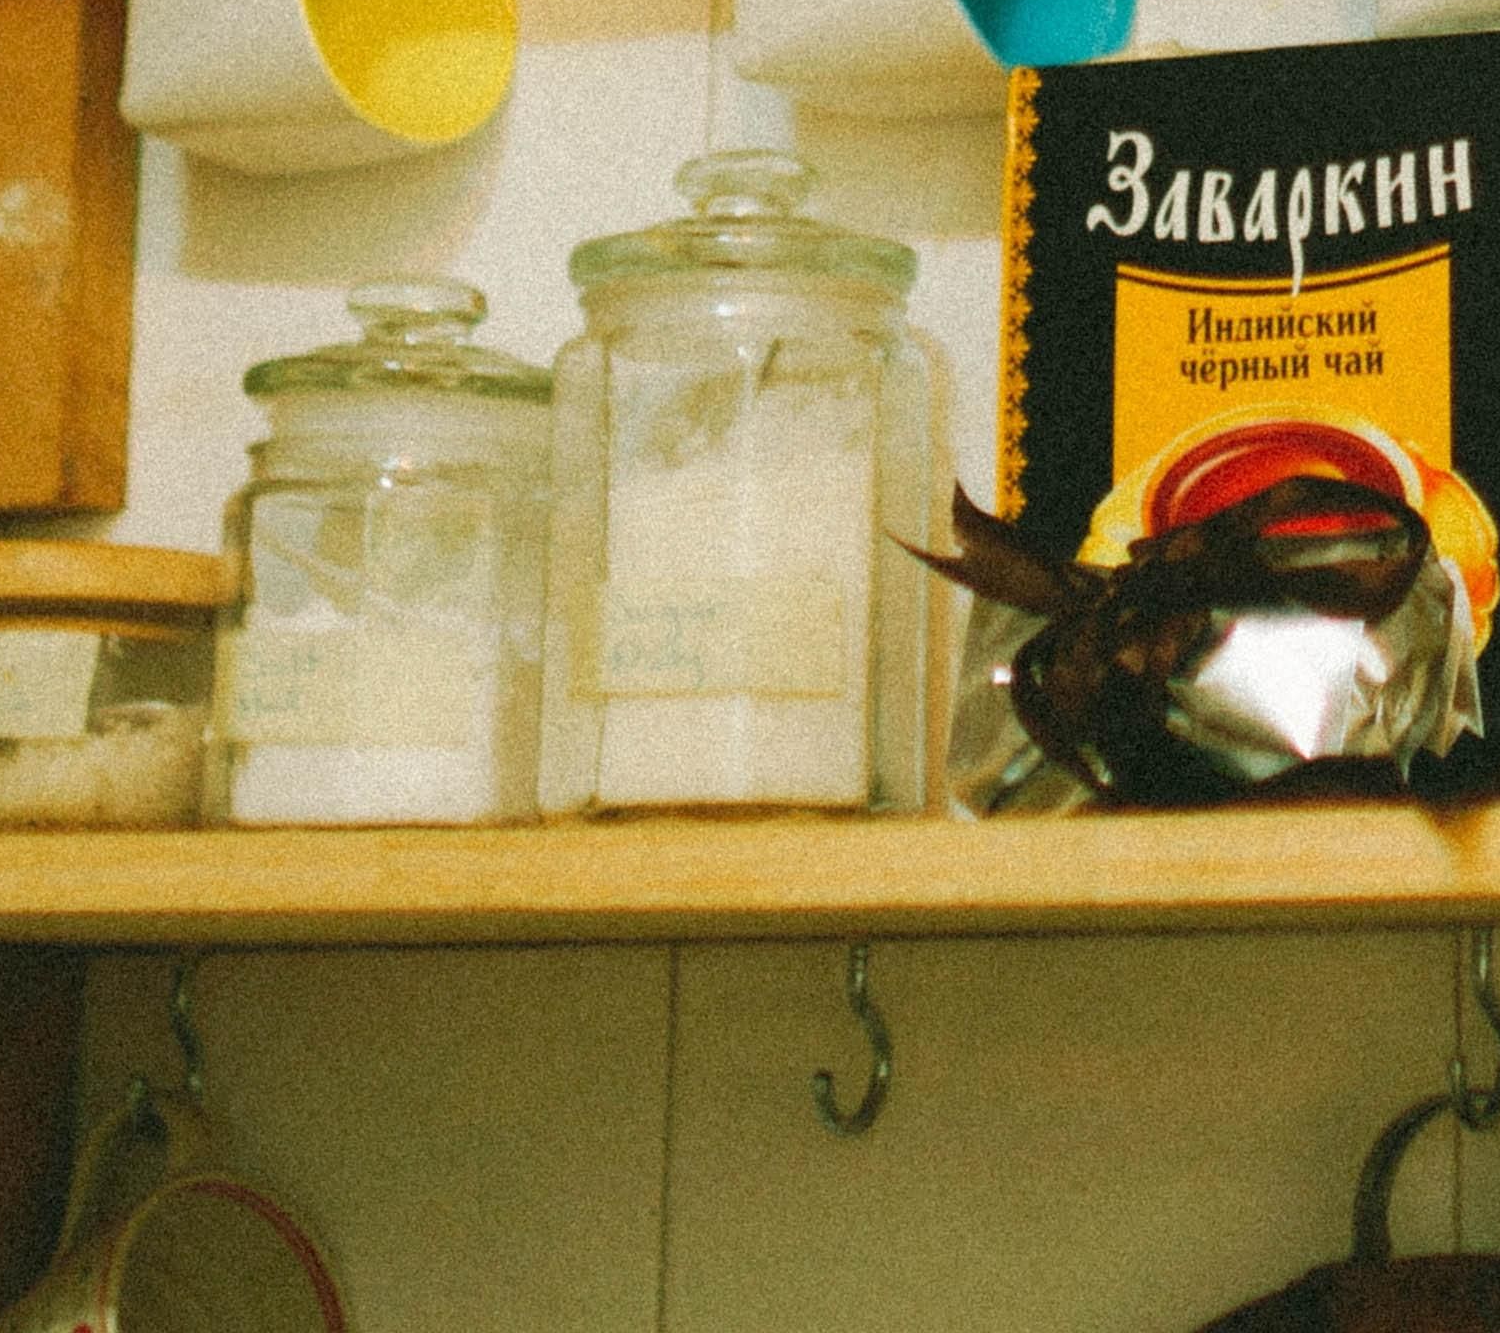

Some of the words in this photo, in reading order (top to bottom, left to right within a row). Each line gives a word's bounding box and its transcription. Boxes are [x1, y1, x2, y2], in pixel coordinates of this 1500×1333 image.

[1087, 131, 1472, 297] Заваркин
[1187, 300, 1377, 344] Индийский
[1181, 342, 1310, 389] чёрный
[1324, 339, 1384, 377] чай
